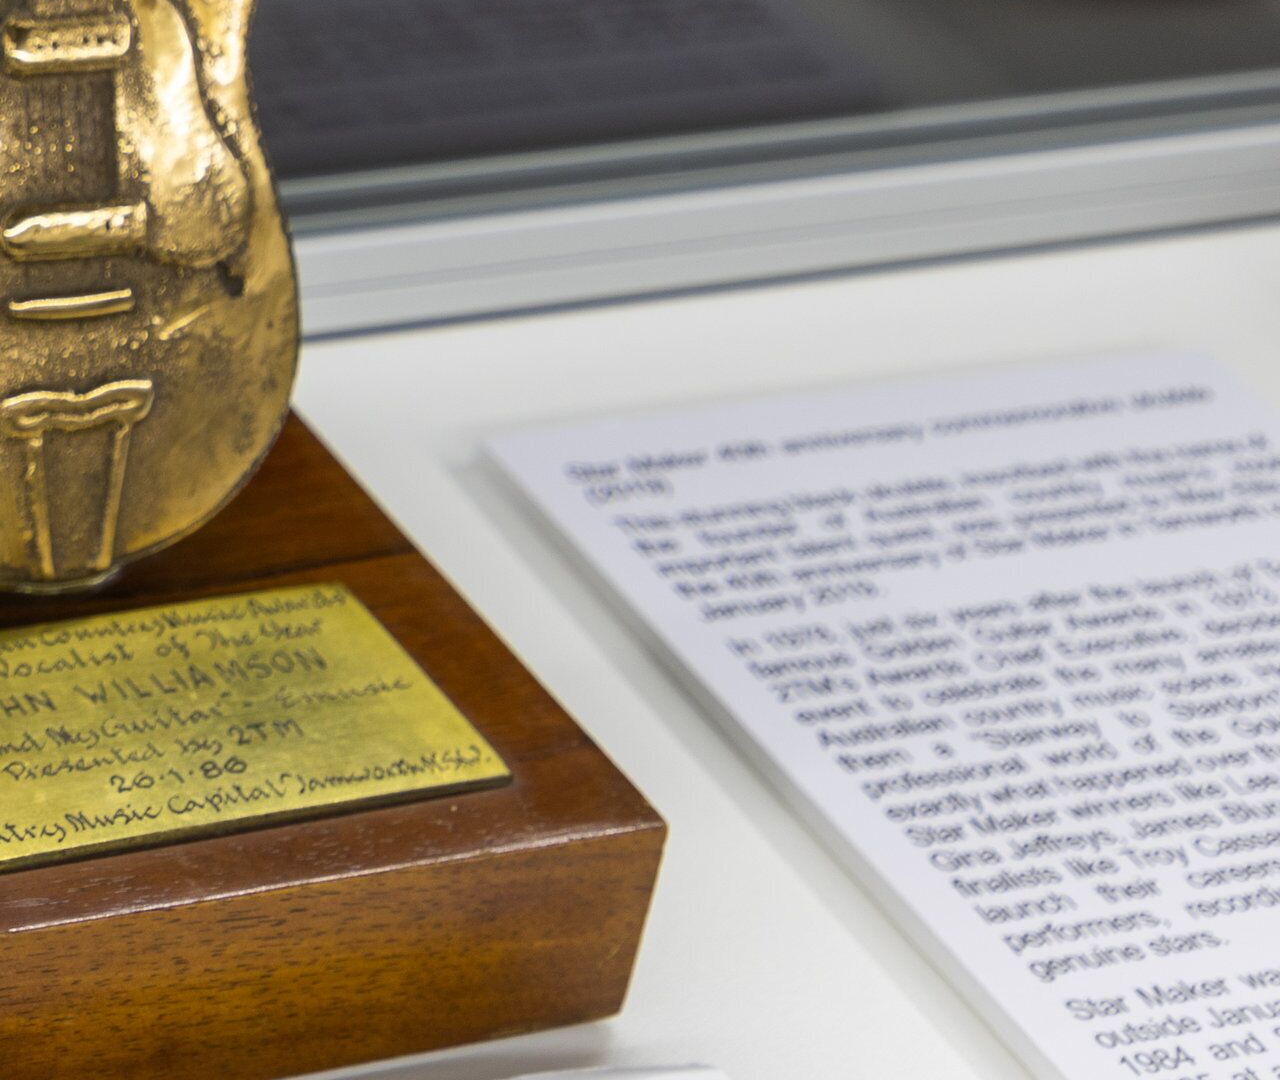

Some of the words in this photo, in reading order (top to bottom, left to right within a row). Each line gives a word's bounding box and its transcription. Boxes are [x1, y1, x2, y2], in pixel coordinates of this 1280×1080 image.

[39, 618, 165, 647] Country
[155, 635, 191, 659] of
[72, 646, 328, 705] WILLIAMSON
[1, 741, 165, 781] Presented
[174, 737, 222, 756] by
[227, 719, 304, 746] 2TM
[45, 725, 100, 750] My
[861, 754, 1030, 802] professional
[1130, 732, 1162, 756] of
[1170, 725, 1223, 749] the
[65, 802, 161, 832] Music
[167, 779, 285, 815] Capital
[884, 793, 985, 822] exactly
[989, 778, 1051, 805] what
[1051, 756, 1194, 794] happened
[903, 823, 967, 849] Star
[967, 809, 1060, 838] Maker
[1065, 789, 1176, 821] winners
[1173, 780, 1228, 804] like
[928, 847, 1005, 874] Gina
[1128, 811, 1224, 841] James
[950, 868, 1064, 900] finalists
[1062, 856, 1122, 879] like
[1120, 846, 1191, 871] Troy
[972, 891, 1079, 926] launch
[1095, 877, 1162, 904] their
[1001, 912, 1173, 957] performers,
[1028, 946, 1147, 984] genuine
[1064, 995, 1130, 1022] Star
[1133, 978, 1231, 1010] Maker
[1094, 1013, 1203, 1050] outside
[1119, 1044, 1197, 1078] 1984
[1207, 1030, 1268, 1062] and
